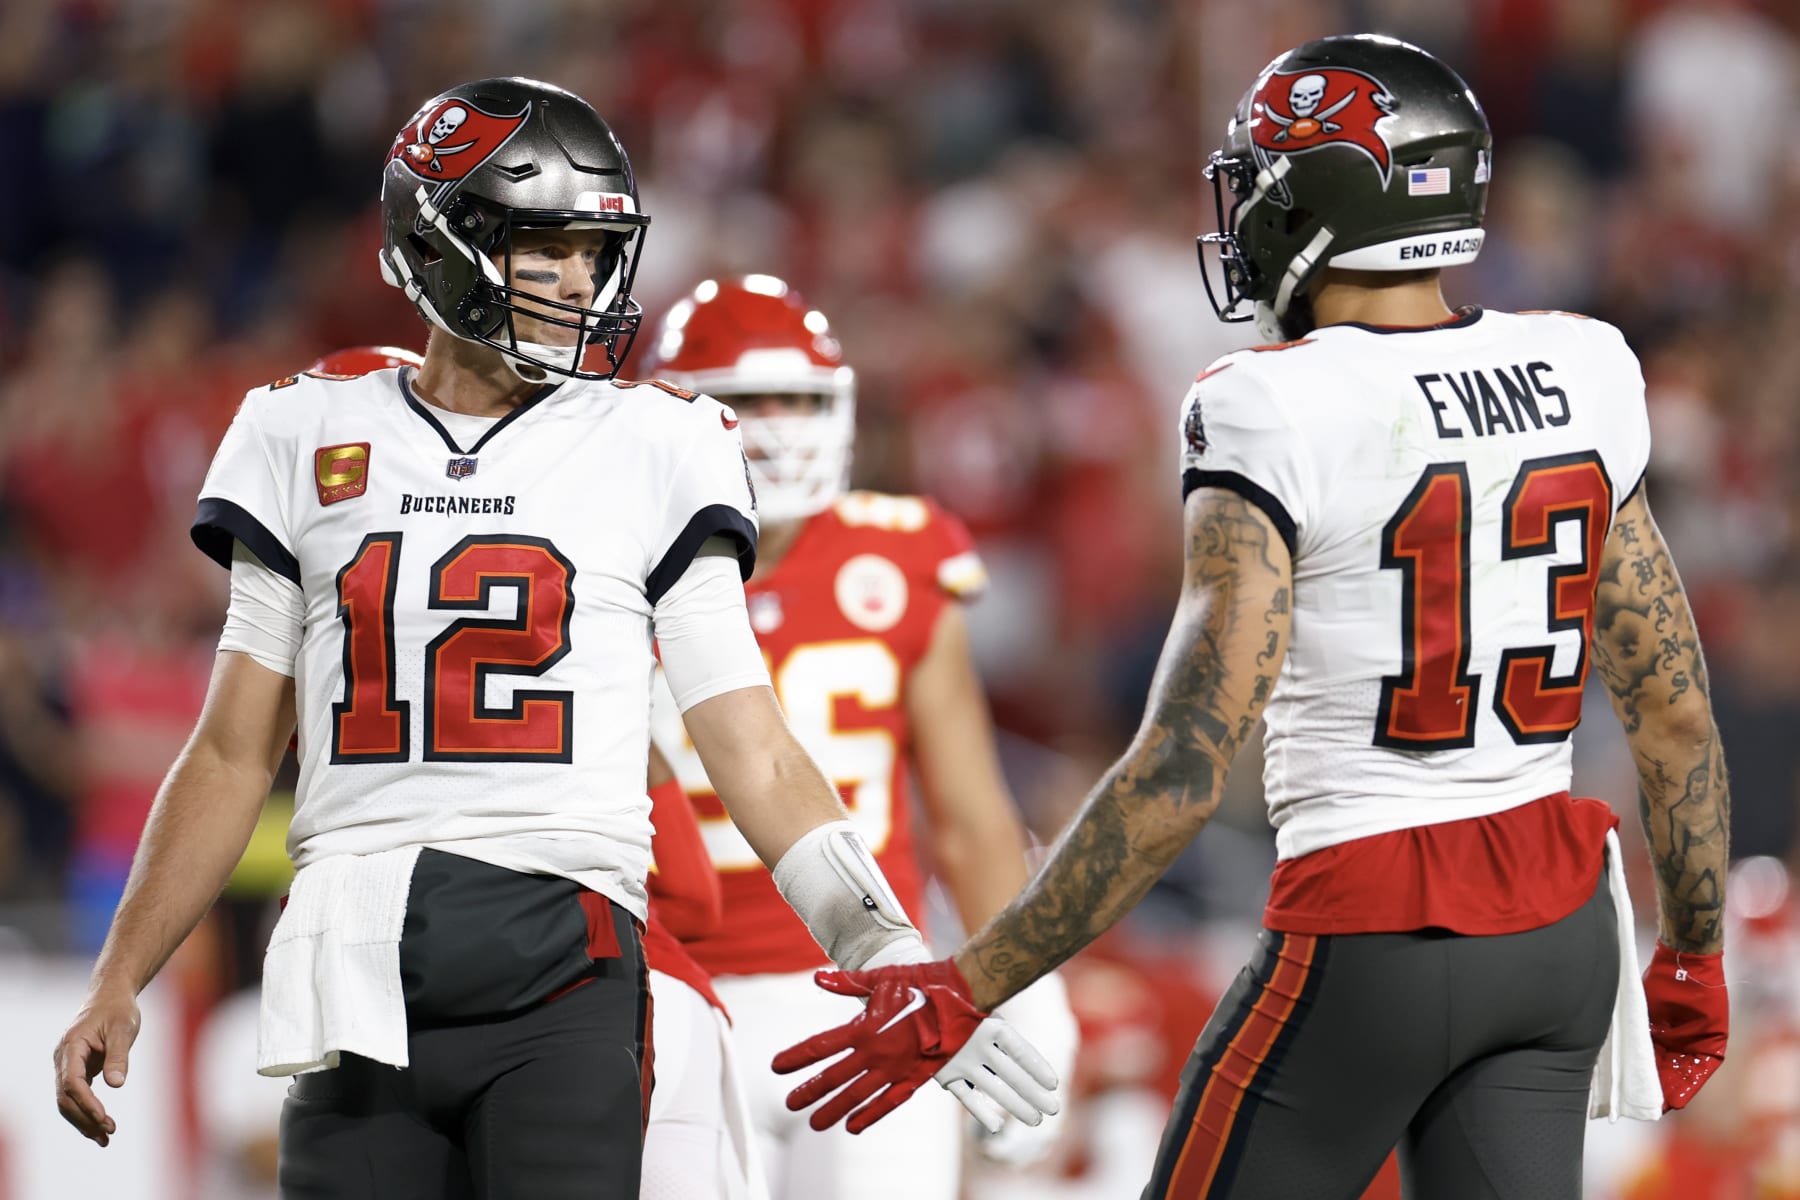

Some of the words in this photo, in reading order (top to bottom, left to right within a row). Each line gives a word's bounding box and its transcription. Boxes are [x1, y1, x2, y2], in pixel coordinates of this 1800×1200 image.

[1400, 243, 1437, 260] END
[1414, 361, 1571, 439] EVANS
[319, 446, 367, 488] C
[1372, 448, 1614, 751] 13
[329, 531, 577, 765] 12
